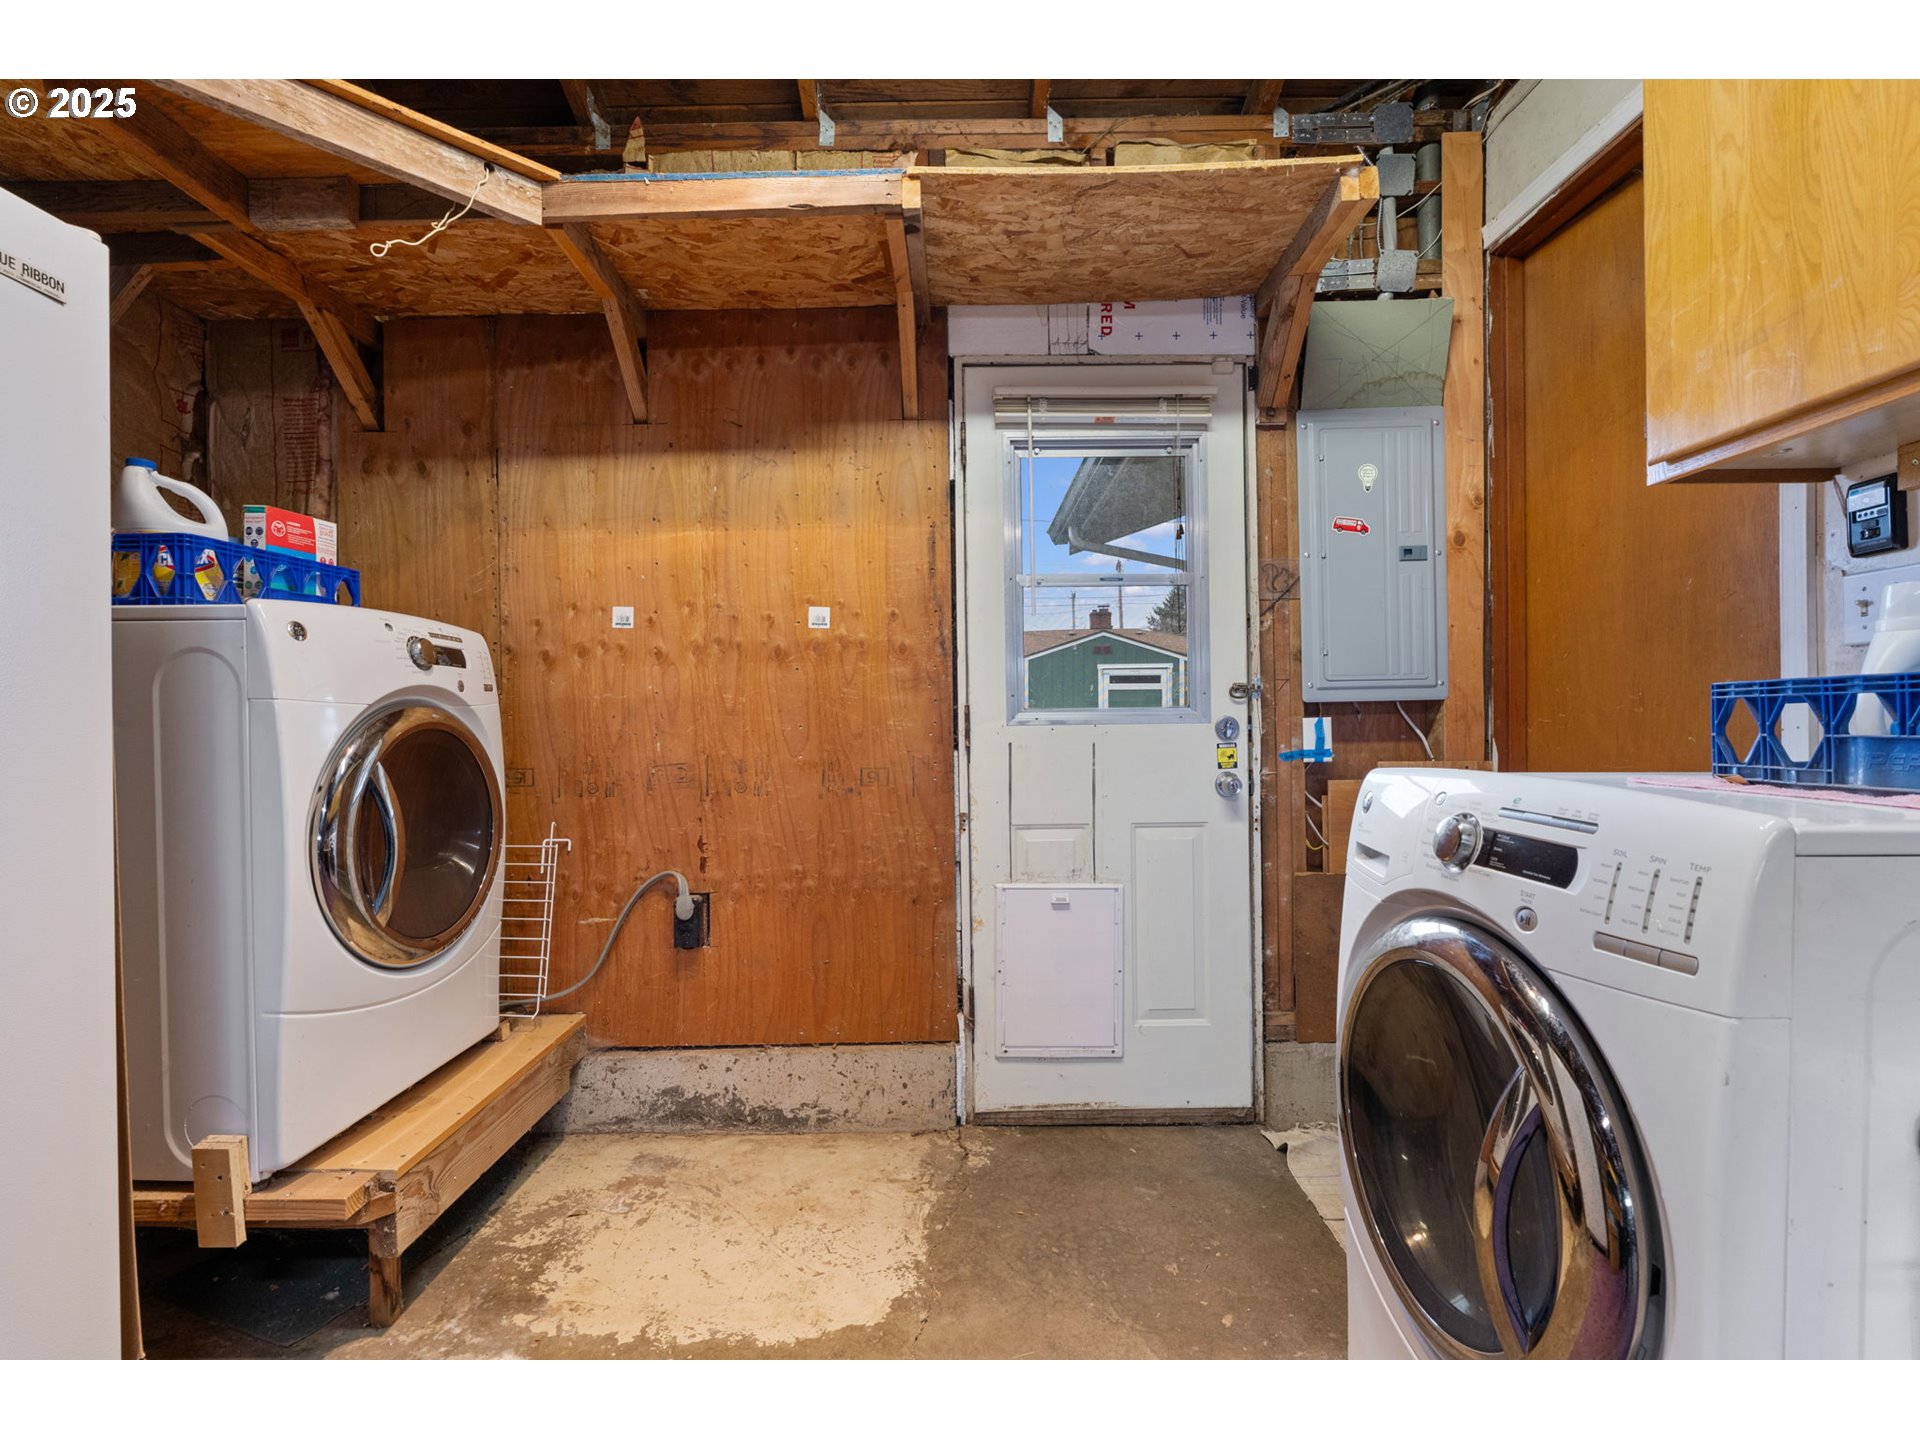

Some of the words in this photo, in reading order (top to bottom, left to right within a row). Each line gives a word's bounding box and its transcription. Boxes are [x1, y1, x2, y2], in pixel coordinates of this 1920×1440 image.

[21, 262, 65, 294] RIBBON
[1649, 855, 1667, 865] SPIN
[1689, 862, 1712, 873] TEMP
